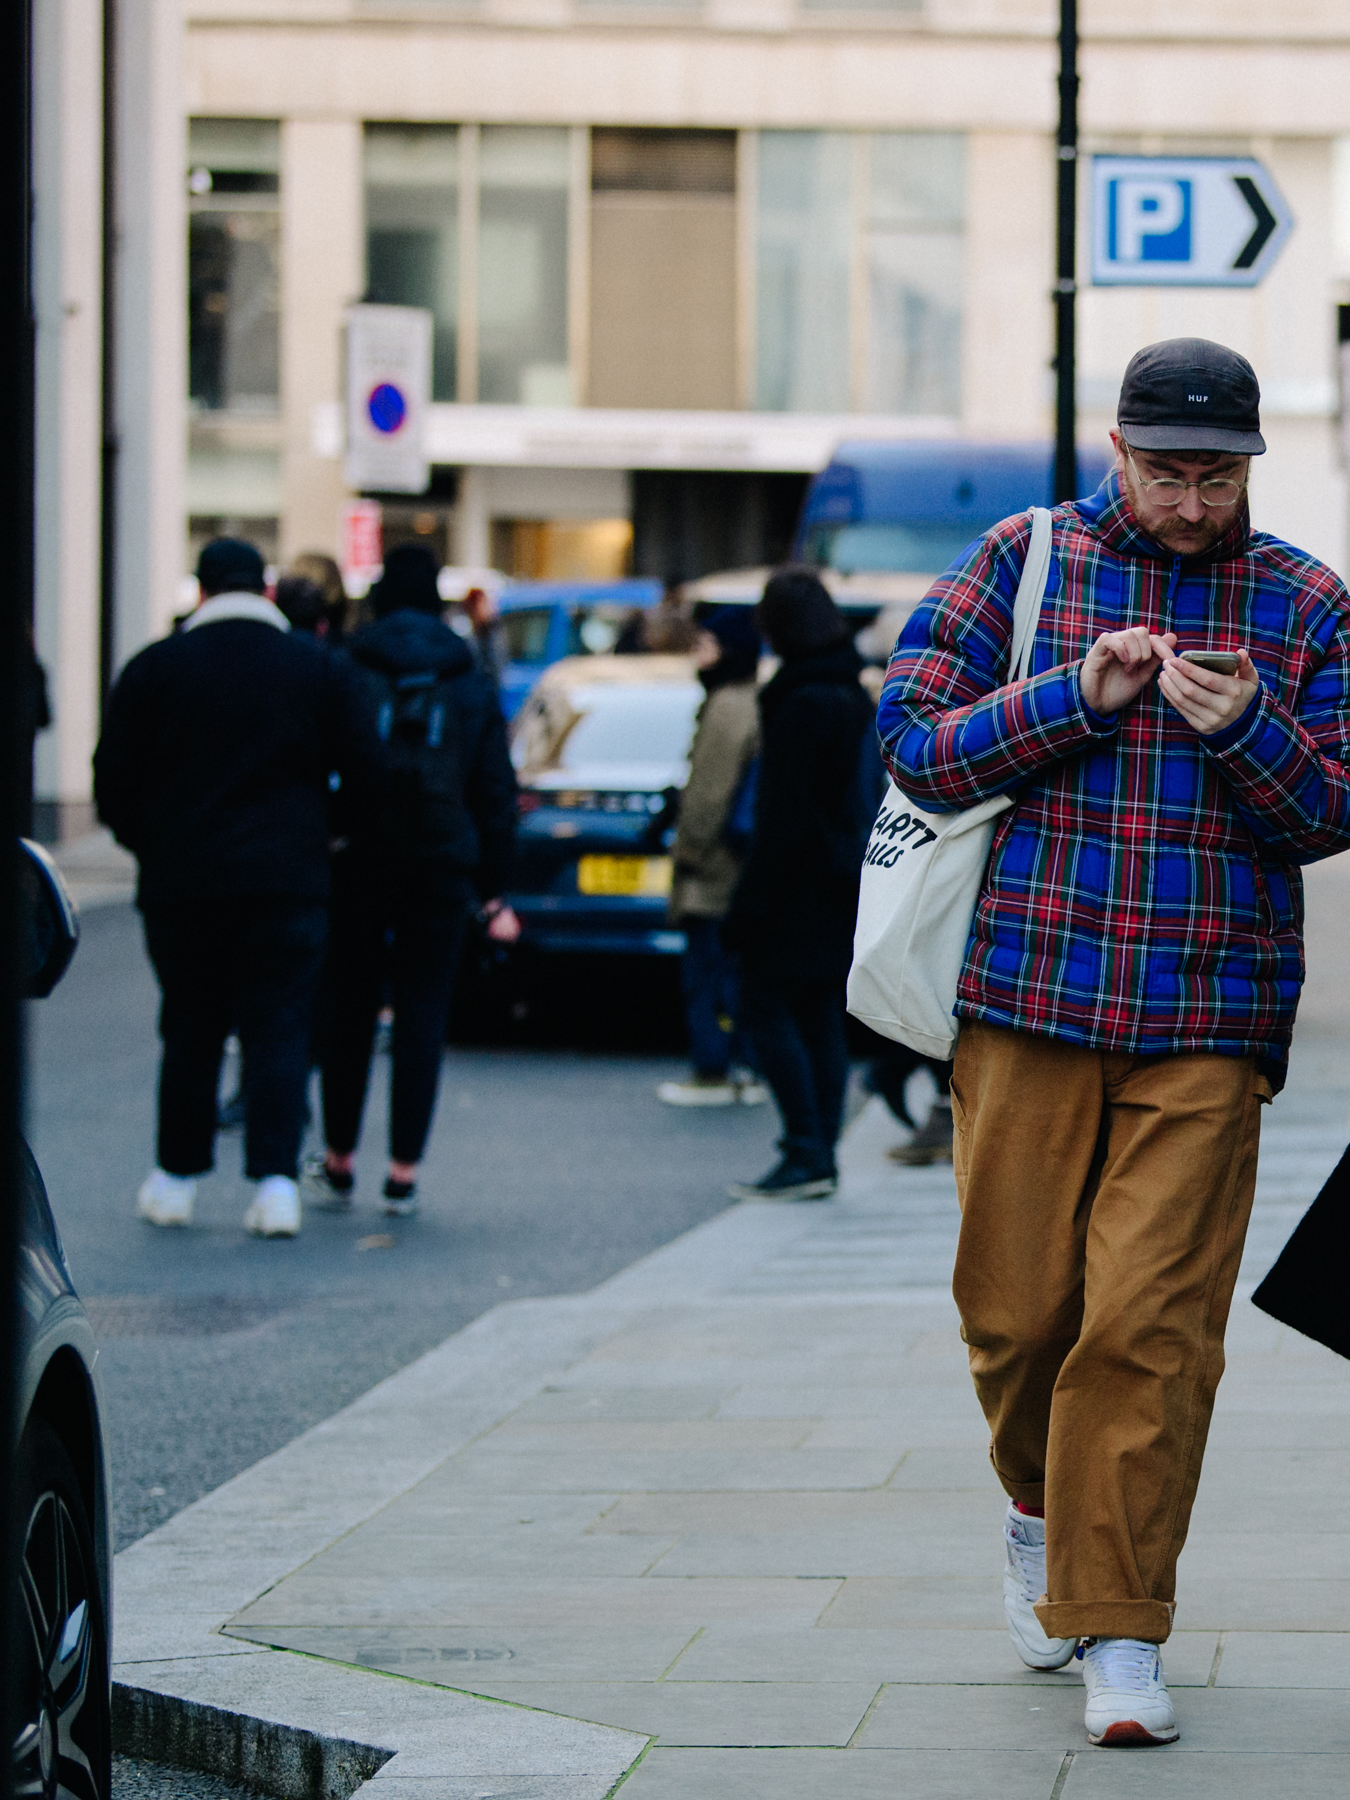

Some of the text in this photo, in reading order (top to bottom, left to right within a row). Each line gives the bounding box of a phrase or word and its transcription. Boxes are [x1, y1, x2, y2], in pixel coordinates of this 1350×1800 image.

[1116, 177, 1185, 262] P
[1188, 394, 1209, 403] HUF
[873, 805, 938, 850] ARTT
[864, 841, 905, 869] ALLS
